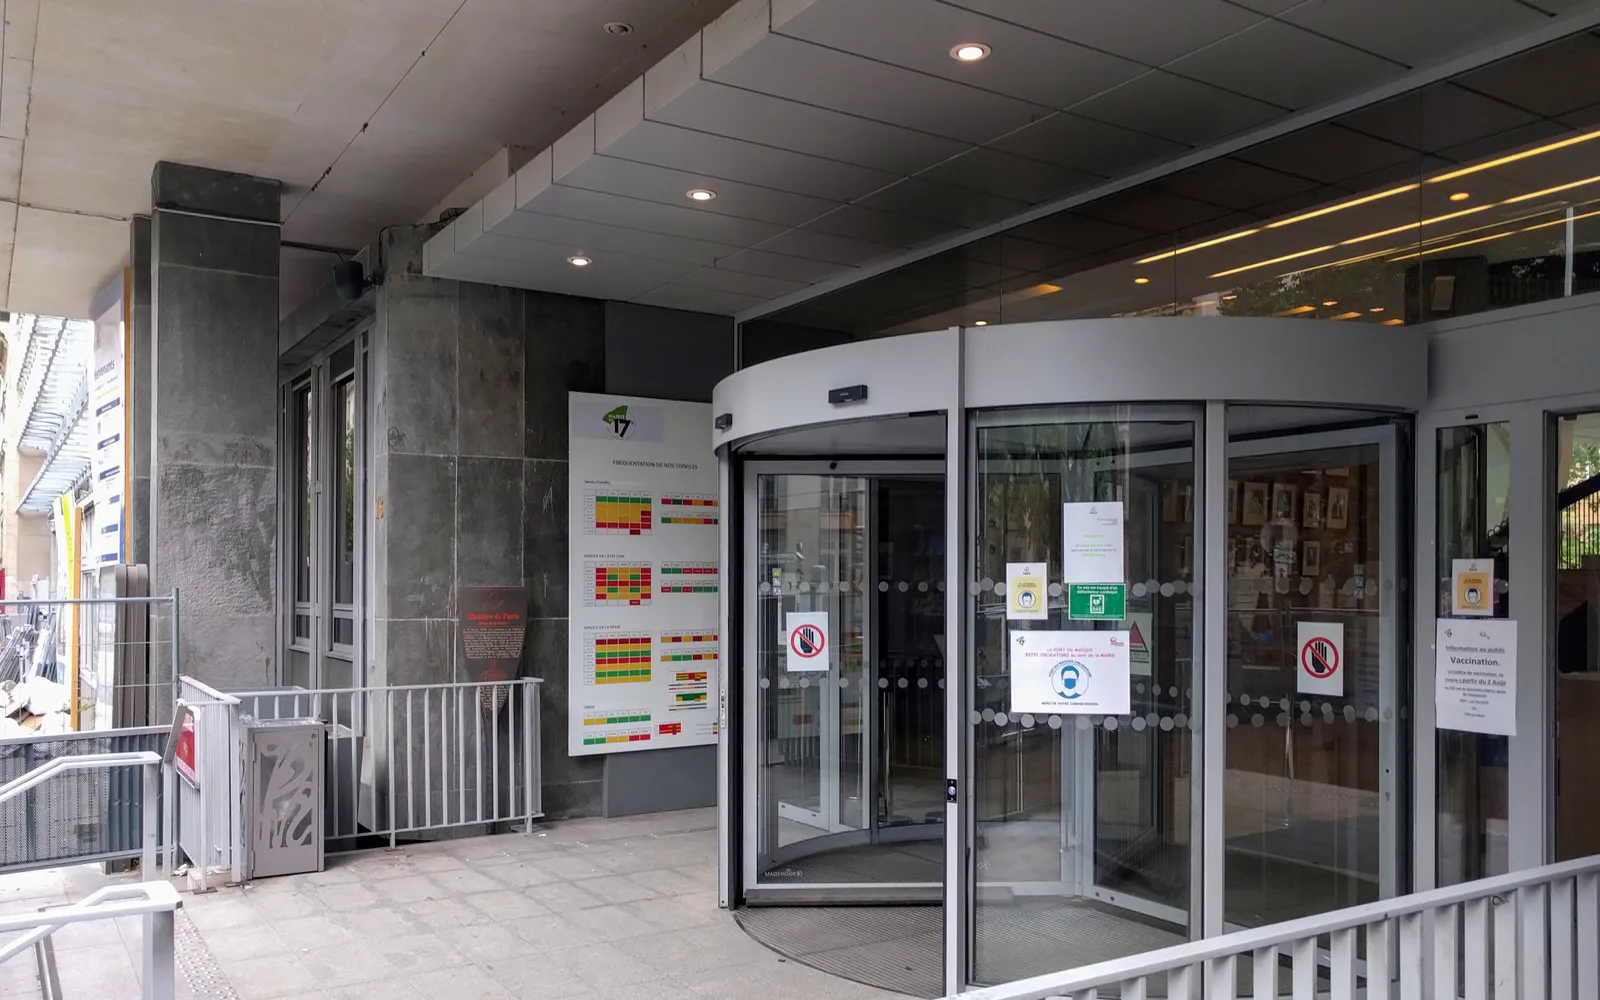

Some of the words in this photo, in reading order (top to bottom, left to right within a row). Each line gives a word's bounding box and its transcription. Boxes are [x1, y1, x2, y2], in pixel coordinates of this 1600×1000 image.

[1487, 646, 1506, 655] public
[1450, 656, 1501, 667] Vaccination.
[1491, 679, 1506, 687] Août
